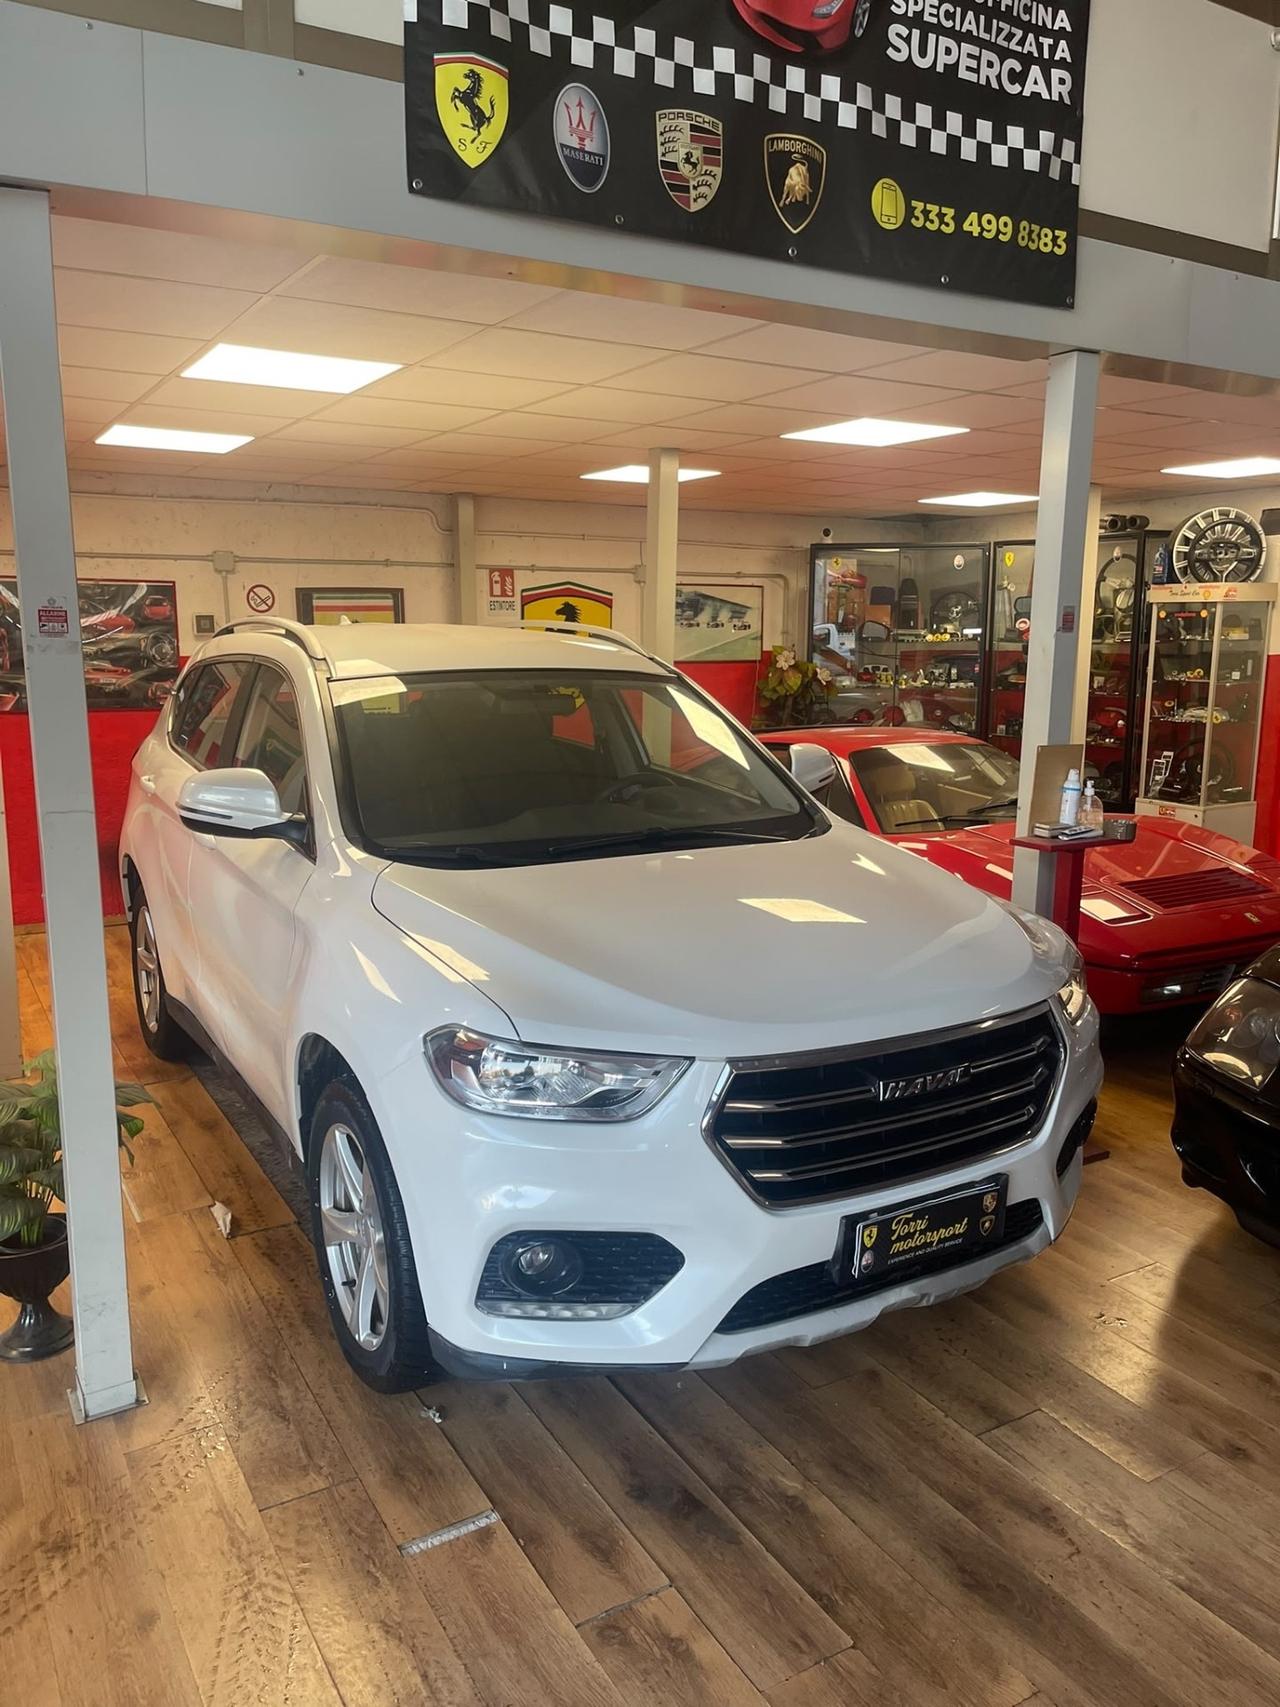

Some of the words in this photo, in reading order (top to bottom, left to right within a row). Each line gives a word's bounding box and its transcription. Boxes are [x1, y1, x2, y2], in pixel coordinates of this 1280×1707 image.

[890, 0, 1072, 63] SPECIALIZZATA
[886, 23, 1072, 105] SUPERCAR
[658, 111, 720, 132] PORSCHE
[458, 138, 468, 152] S
[563, 147, 604, 166] MASERATI
[768, 138, 822, 165] LAMBORGHINI
[910, 200, 956, 234] 333
[962, 211, 1013, 242] 499
[1017, 220, 1067, 256] 8383
[489, 600, 516, 611] ESTINTORE
[889, 1217, 969, 1255] motorsport
[891, 1213, 929, 1241] Torri
